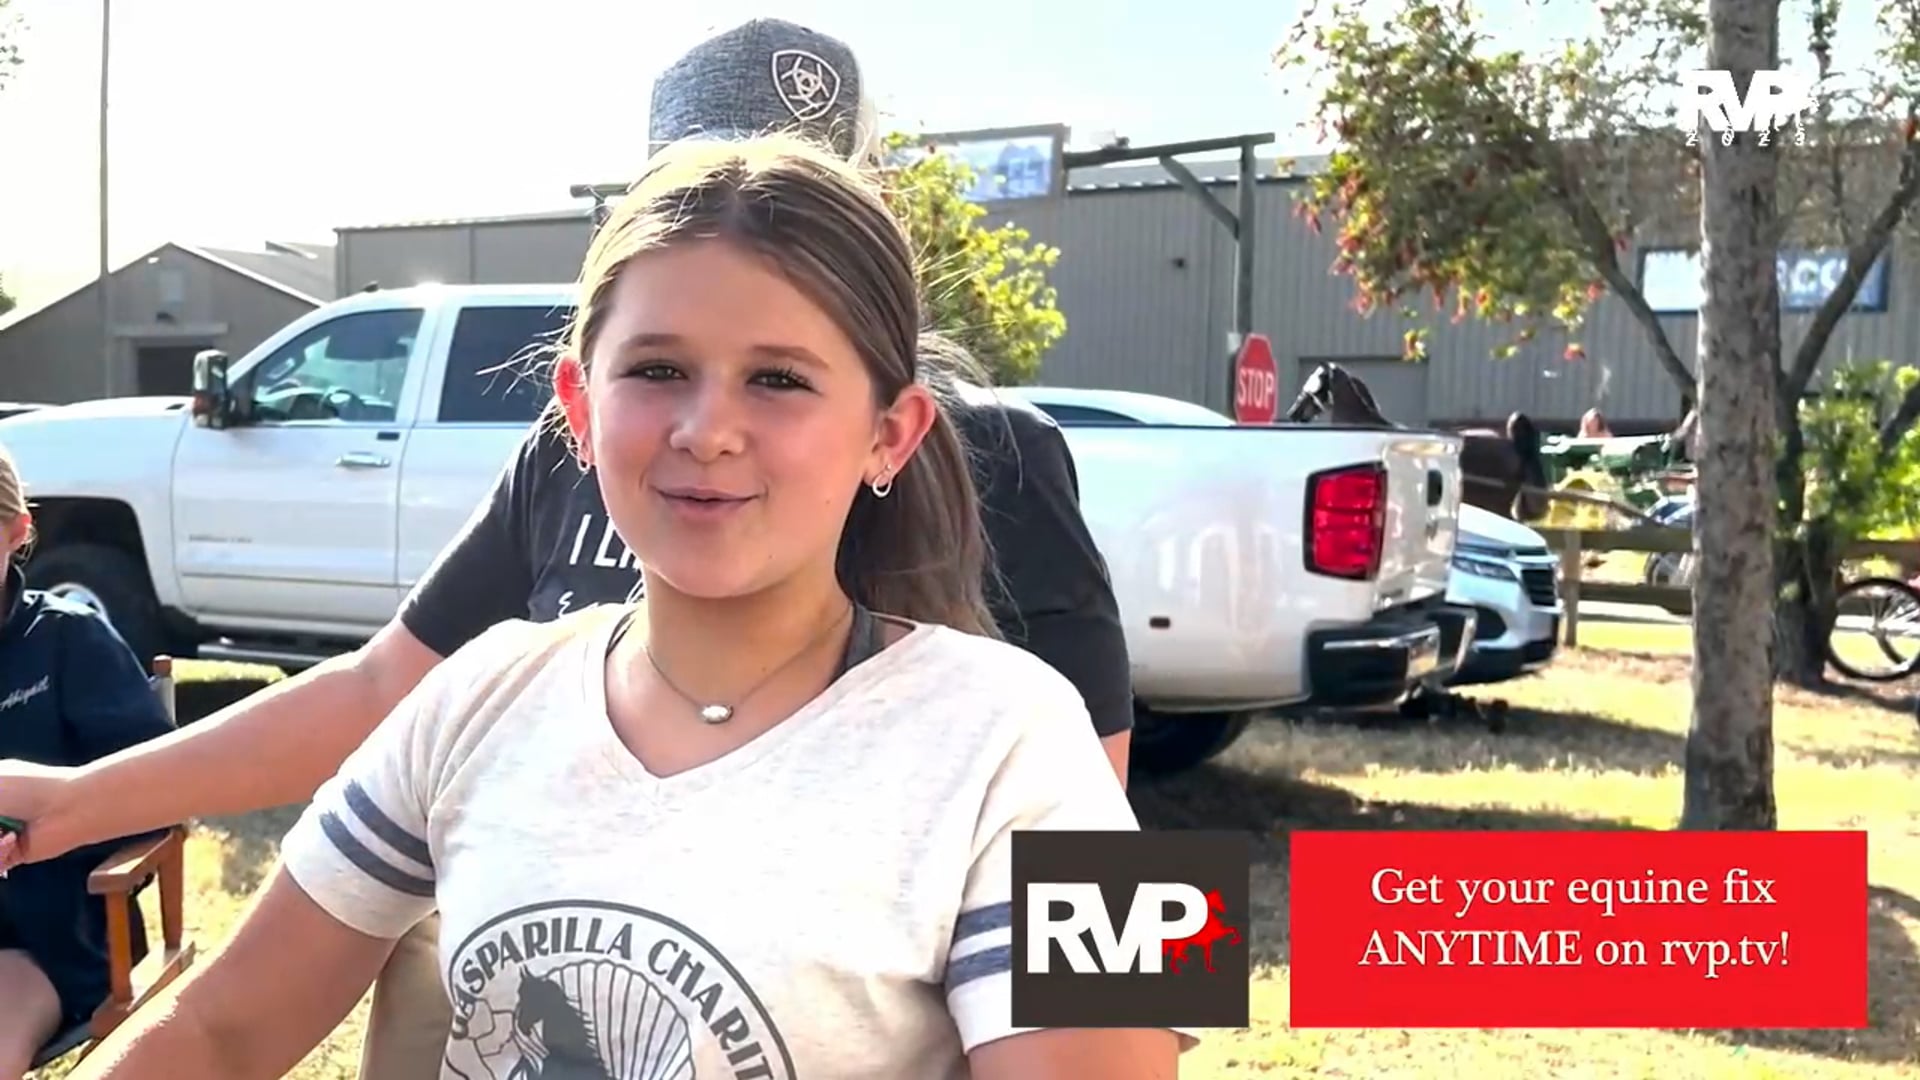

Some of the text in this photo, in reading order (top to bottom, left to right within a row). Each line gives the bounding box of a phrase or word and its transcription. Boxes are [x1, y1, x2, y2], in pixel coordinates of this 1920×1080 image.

[1239, 367, 1274, 409] STOP
[569, 513, 592, 565] I
[451, 916, 634, 1040] GASPARILLA
